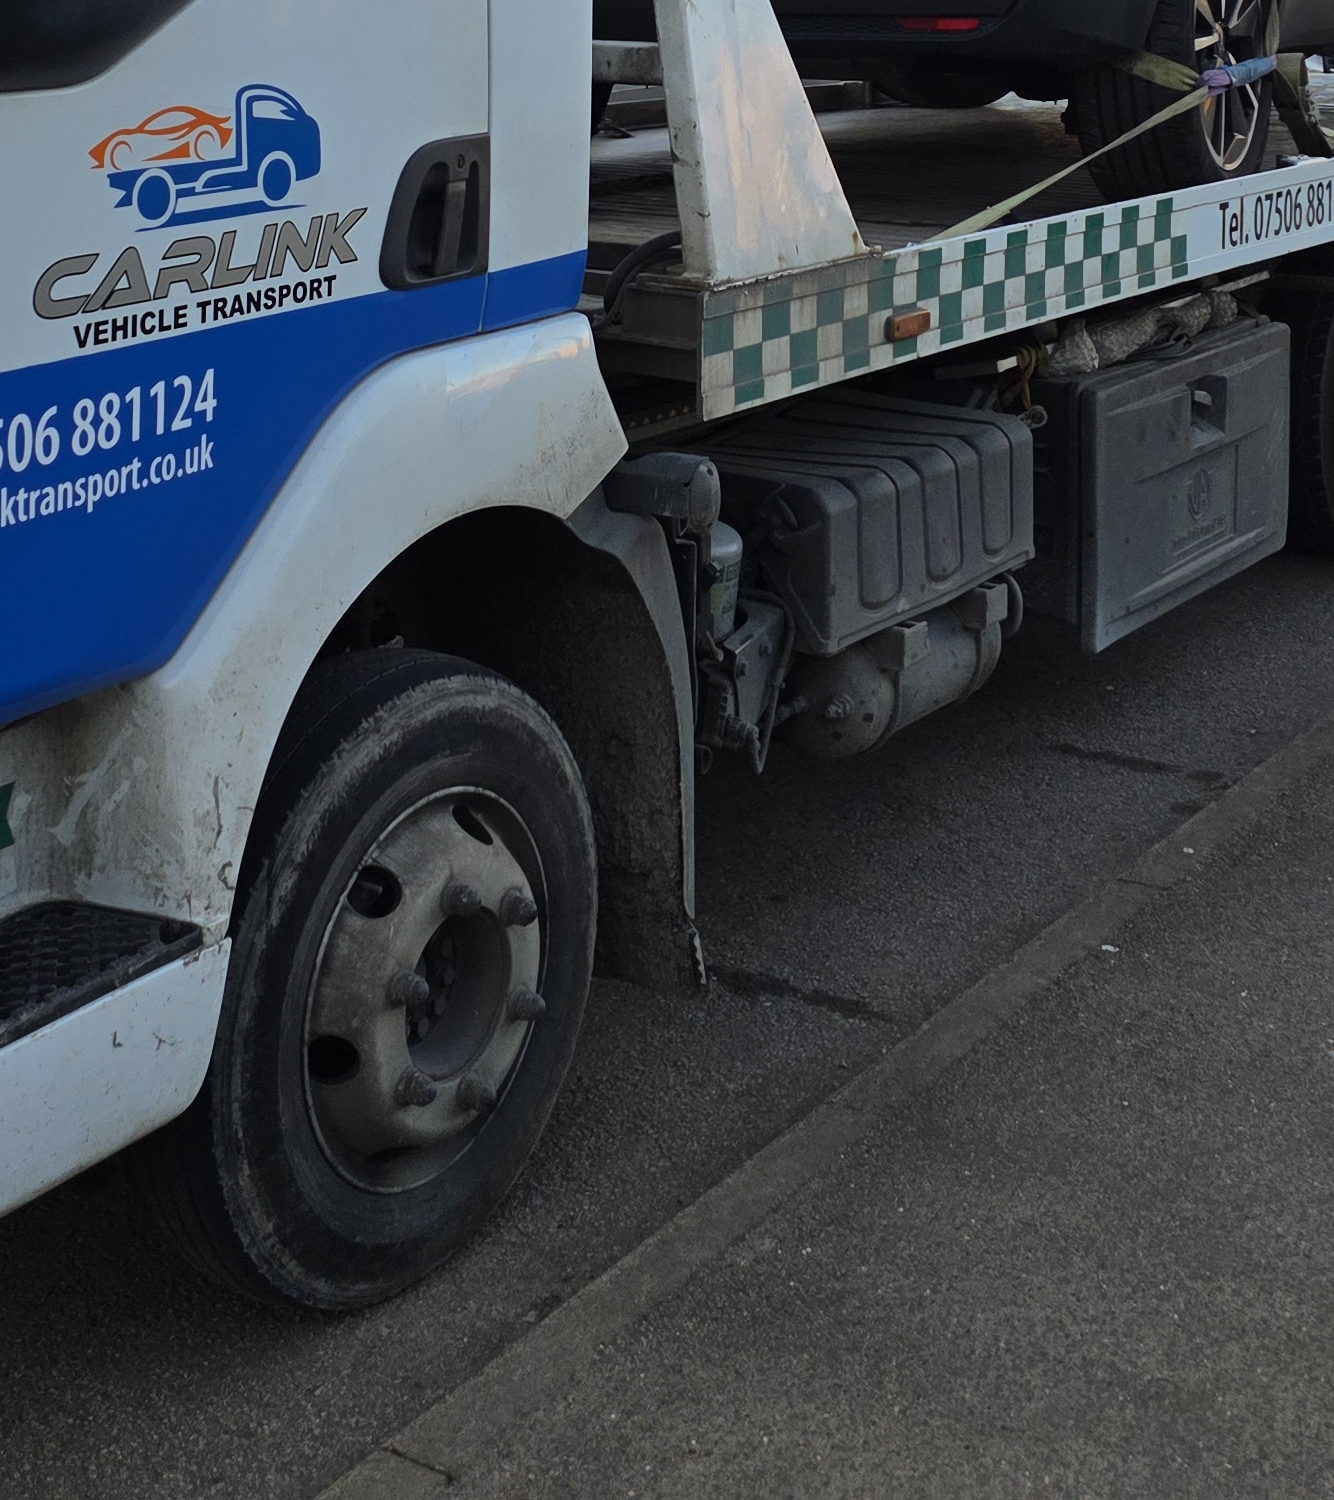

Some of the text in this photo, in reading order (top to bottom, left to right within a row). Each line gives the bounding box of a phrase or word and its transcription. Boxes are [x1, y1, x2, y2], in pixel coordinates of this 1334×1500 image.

[1219, 196, 1249, 250] Tel.
[1254, 187, 1303, 241] 07506
[32, 206, 368, 320] CARLINK
[73, 274, 337, 349] VEHICLE TRANSPORT
[71, 368, 217, 457] 881124
